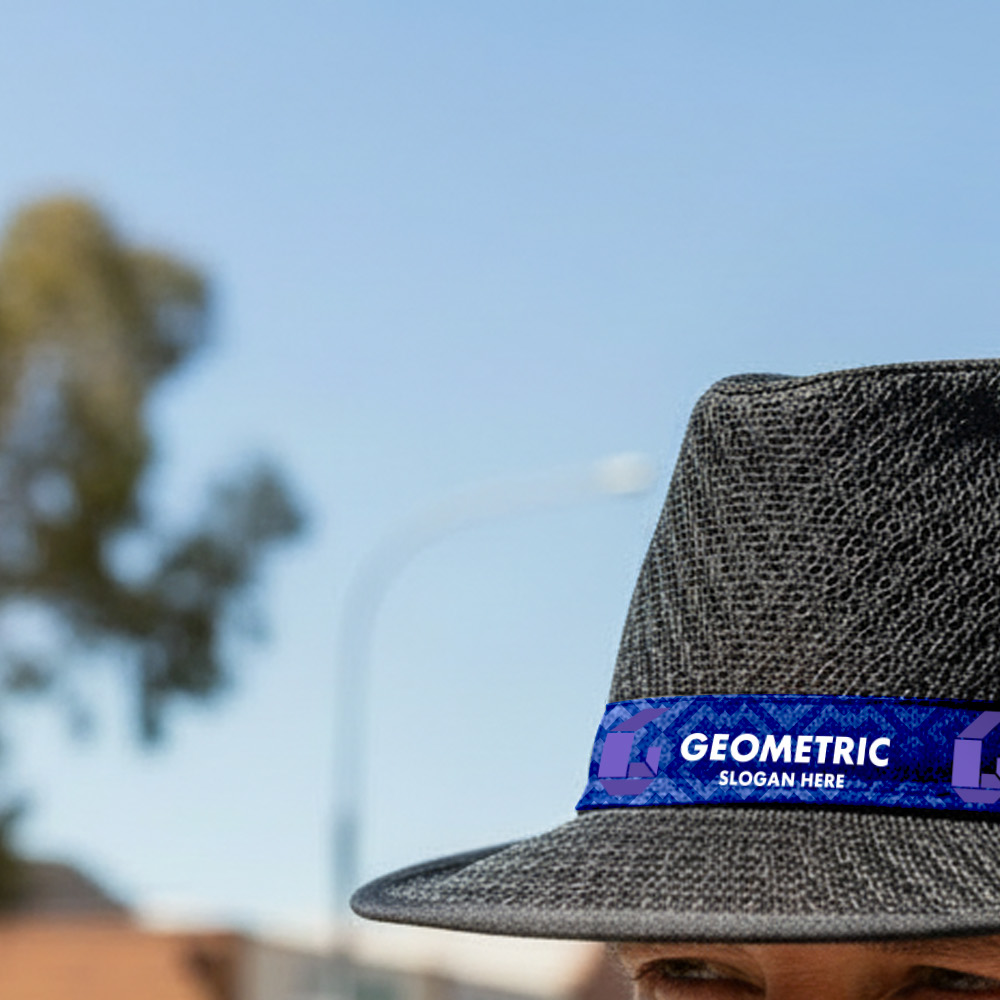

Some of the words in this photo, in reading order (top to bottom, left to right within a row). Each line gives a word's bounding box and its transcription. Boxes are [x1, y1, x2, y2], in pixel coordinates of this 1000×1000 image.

[680, 732, 891, 767] GEOMETRIC
[718, 769, 796, 788] SLOGAN
[800, 772, 845, 789] HERE
